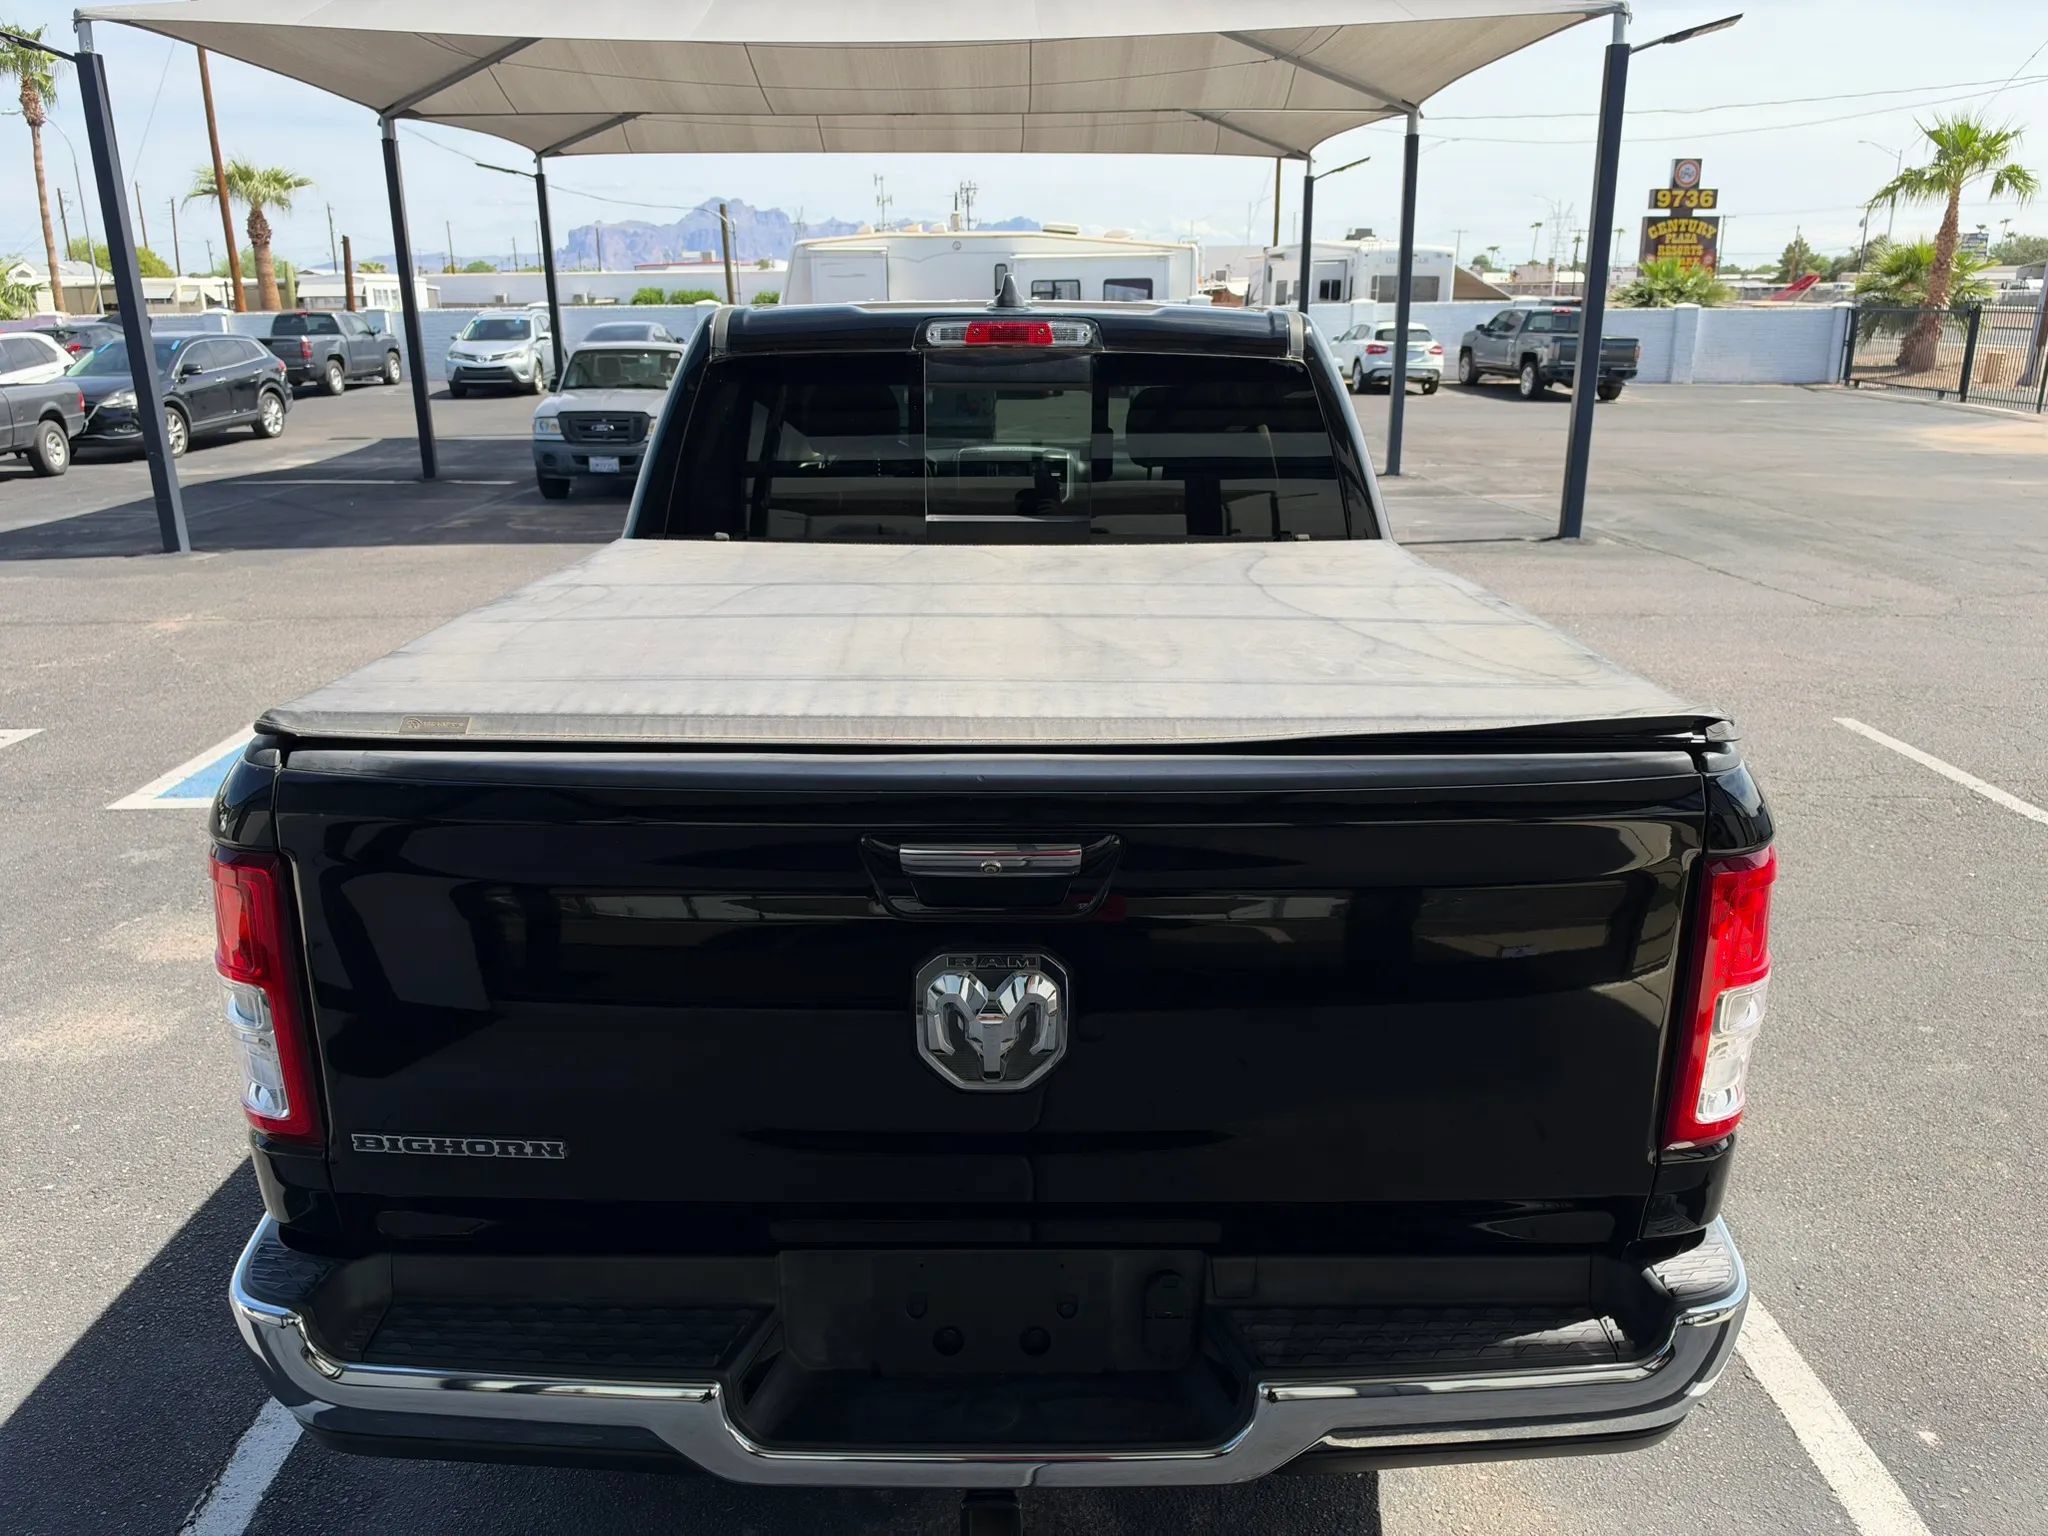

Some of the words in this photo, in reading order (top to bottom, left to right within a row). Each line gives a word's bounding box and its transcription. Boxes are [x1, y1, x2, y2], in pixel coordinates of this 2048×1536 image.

[1657, 190, 1713, 208] 9736
[1648, 218, 1717, 240] CENTURY
[1665, 233, 1698, 244] PLAZA
[946, 955, 1038, 969] RAM
[351, 1134, 565, 1159] BIGHORN
